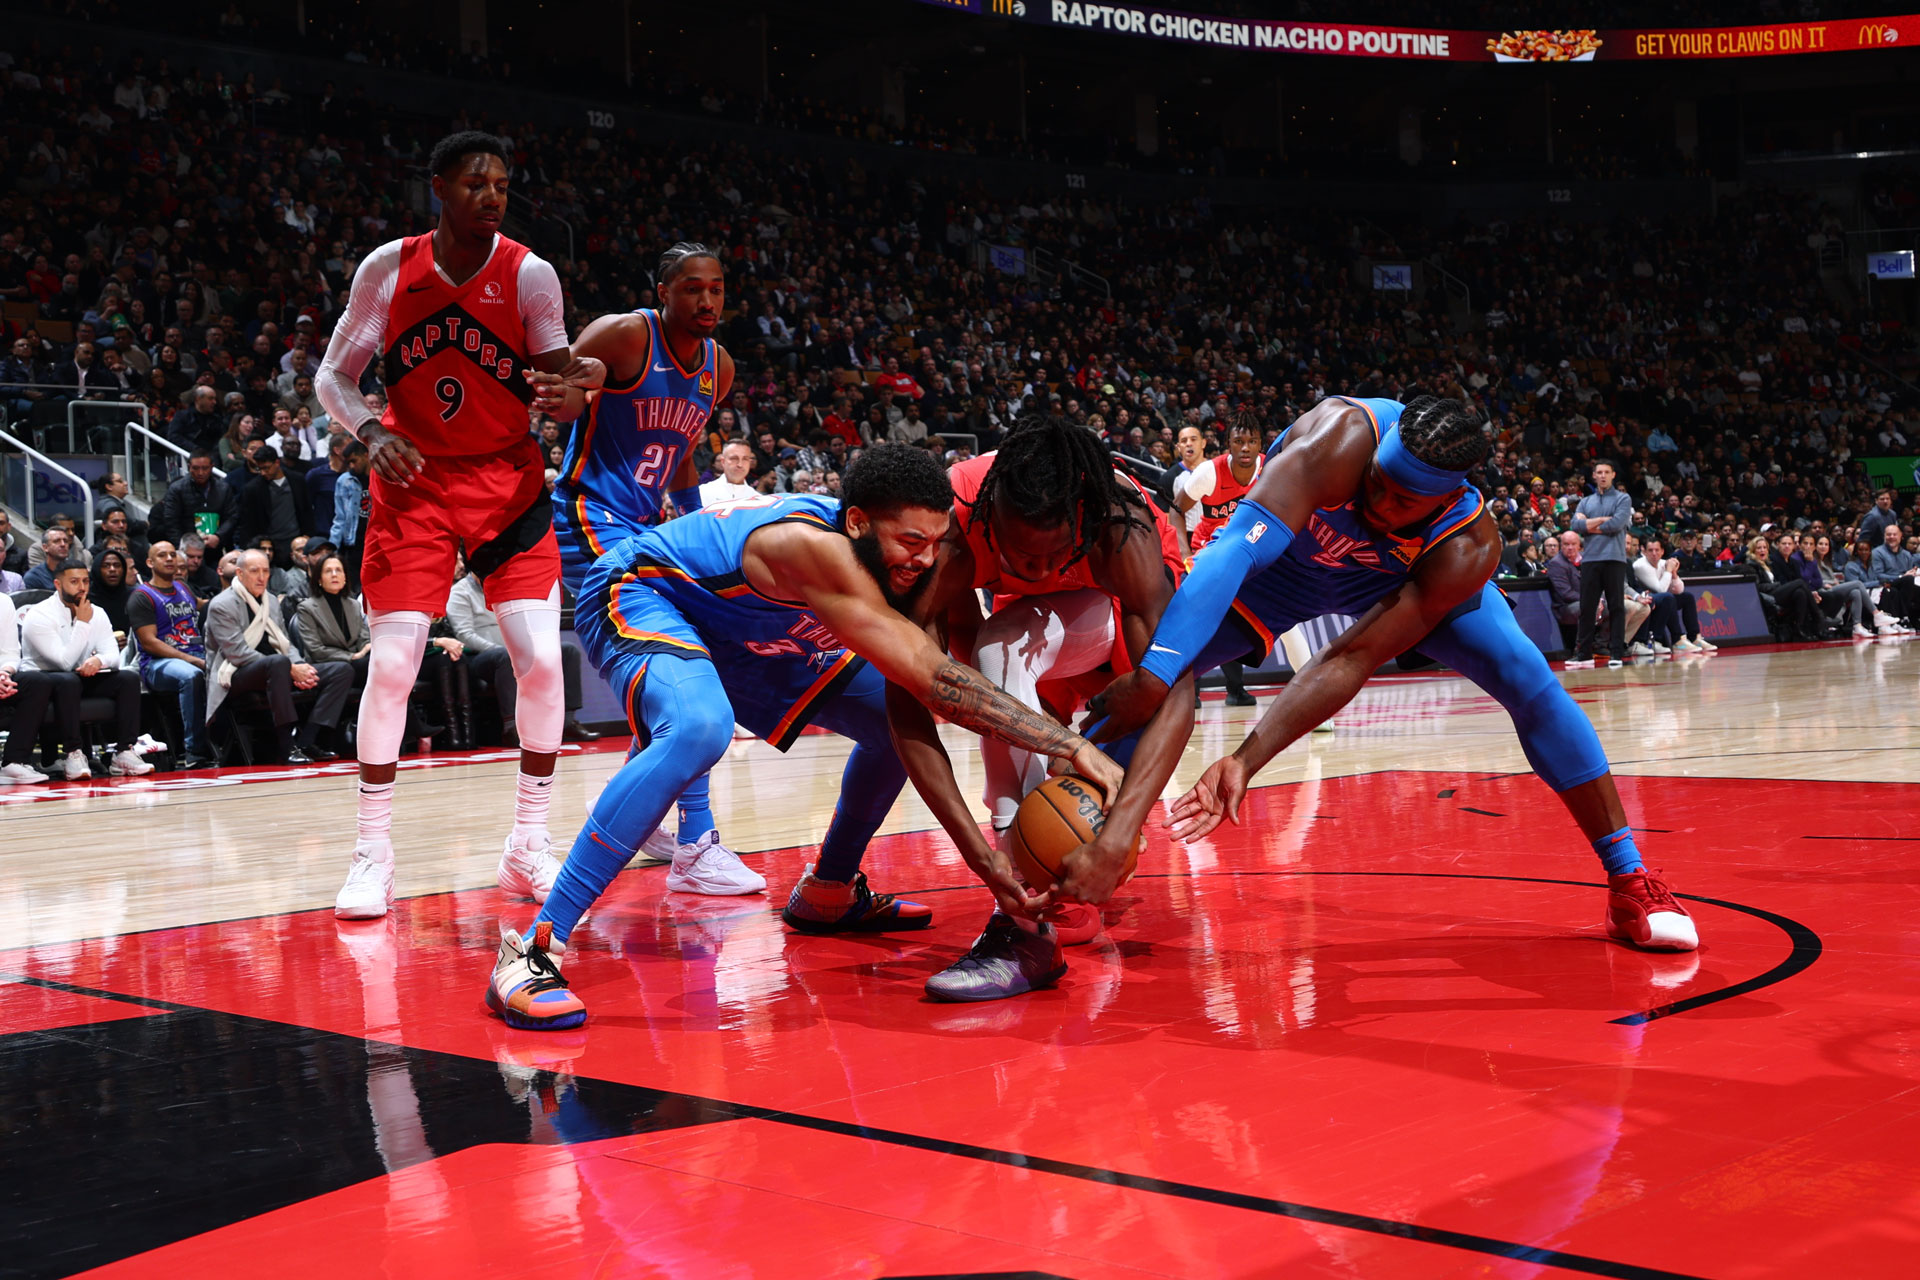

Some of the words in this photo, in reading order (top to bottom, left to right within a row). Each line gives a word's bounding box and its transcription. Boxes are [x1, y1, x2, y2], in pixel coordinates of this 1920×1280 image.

[1052, 0, 1146, 34] RAPTOR
[1150, 13, 1249, 46] CHICKEN
[1255, 25, 1343, 51] NACHO
[1348, 30, 1450, 57] POUTINE
[1636, 34, 1667, 56] GET
[1669, 32, 1713, 55] YOUR
[1717, 30, 1775, 54] CLAWS
[1779, 28, 1803, 51] ON
[1807, 26, 1827, 49] IT
[587, 110, 615, 129] 120
[1065, 174, 1086, 189] 121
[1547, 190, 1571, 202] 122
[1878, 258, 1903, 273] Bell
[401, 317, 513, 380] RAPTORS
[434, 376, 465, 423] 9
[633, 442, 680, 489] 21
[1211, 501, 1238, 518] RAP
[786, 612, 845, 652] THU
